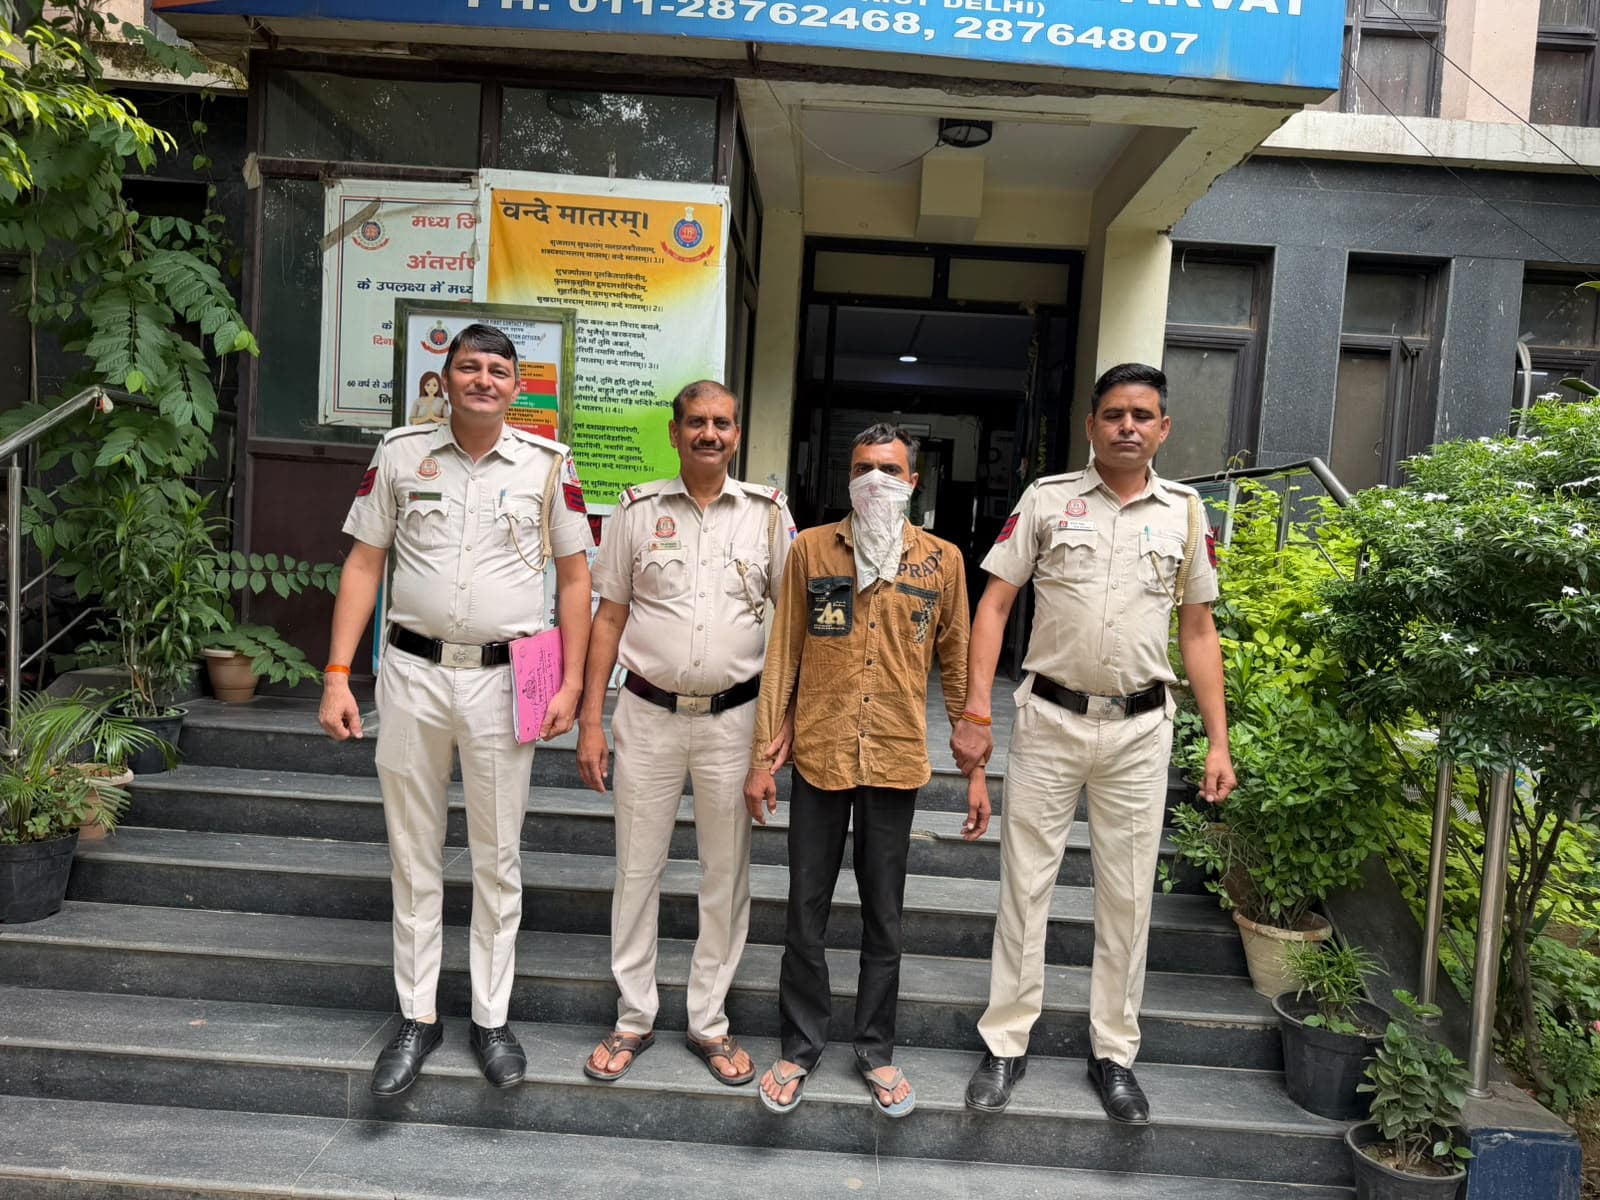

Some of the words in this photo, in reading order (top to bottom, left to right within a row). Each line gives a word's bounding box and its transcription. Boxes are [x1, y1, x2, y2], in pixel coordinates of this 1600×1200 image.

[953, 16, 1199, 56] 28764807
[411, 214, 452, 230] मध्य
[498, 197, 552, 225] वन्दे
[556, 203, 649, 238] मातरम्।
[356, 277, 372, 291] के
[376, 280, 426, 294] उपलक्ष्य
[430, 280, 446, 294] में
[898, 547, 943, 578] PRADA
